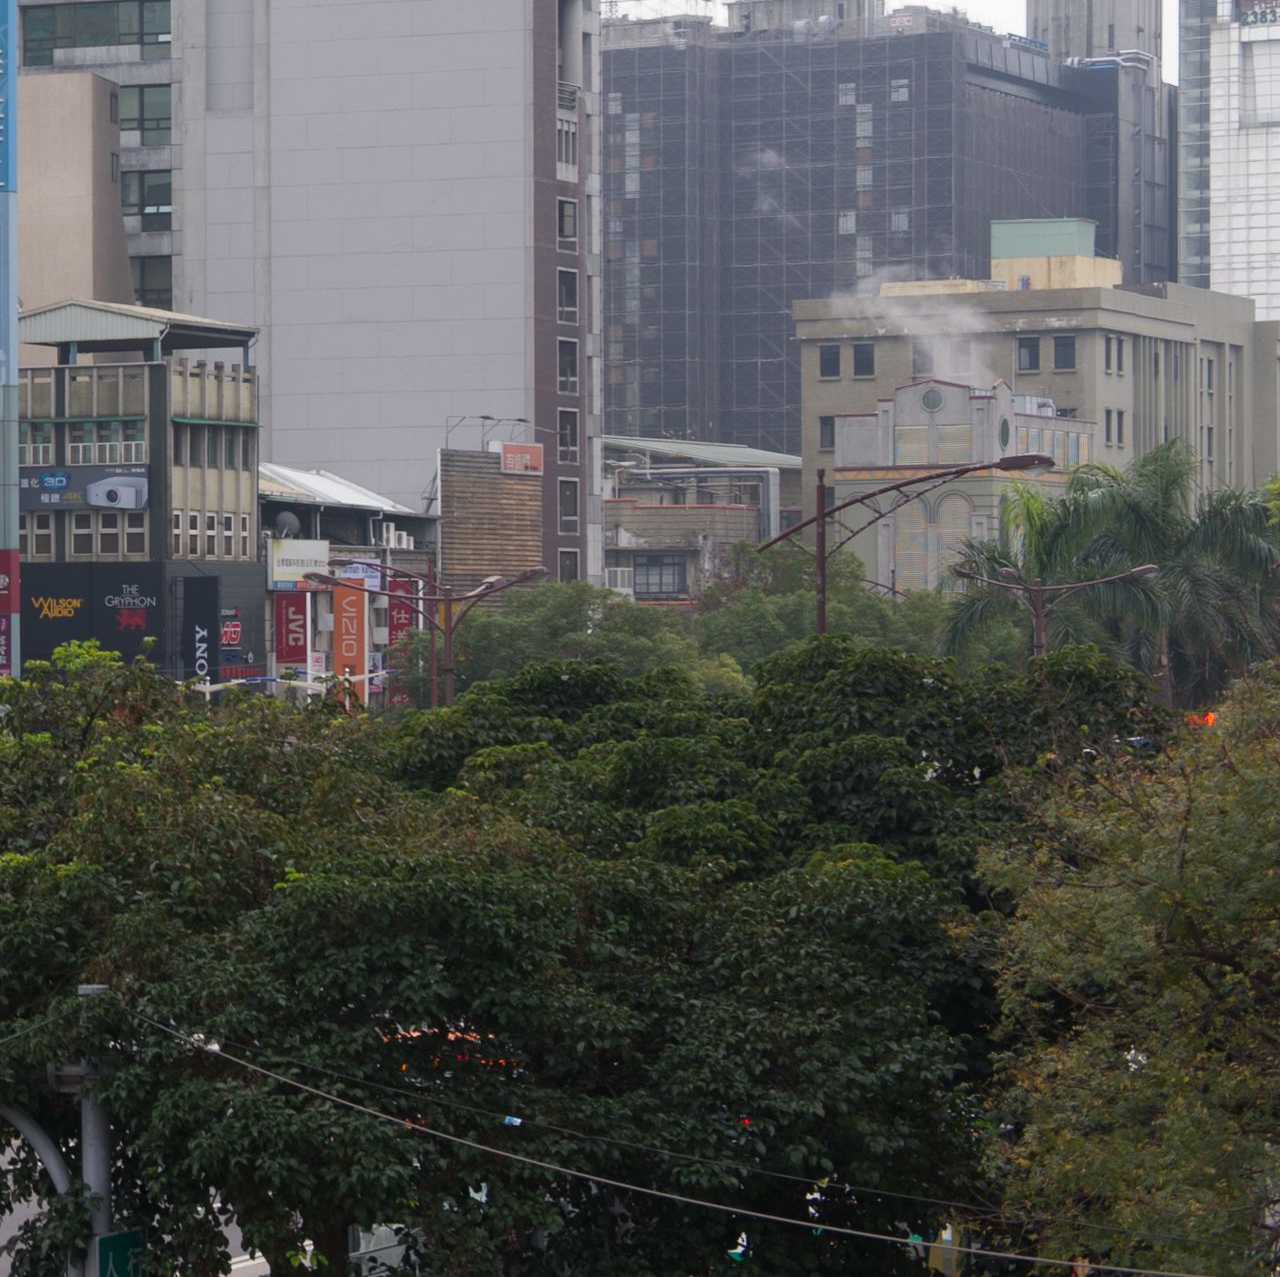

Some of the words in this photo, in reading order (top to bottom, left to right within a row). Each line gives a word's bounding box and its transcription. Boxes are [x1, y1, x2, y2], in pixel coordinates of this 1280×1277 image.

[104, 595, 157, 608] GRYPHON
[122, 584, 139, 595] THE
[287, 607, 304, 646] JVC
[342, 596, 357, 657] VIZIO
[195, 625, 209, 685] ONY
